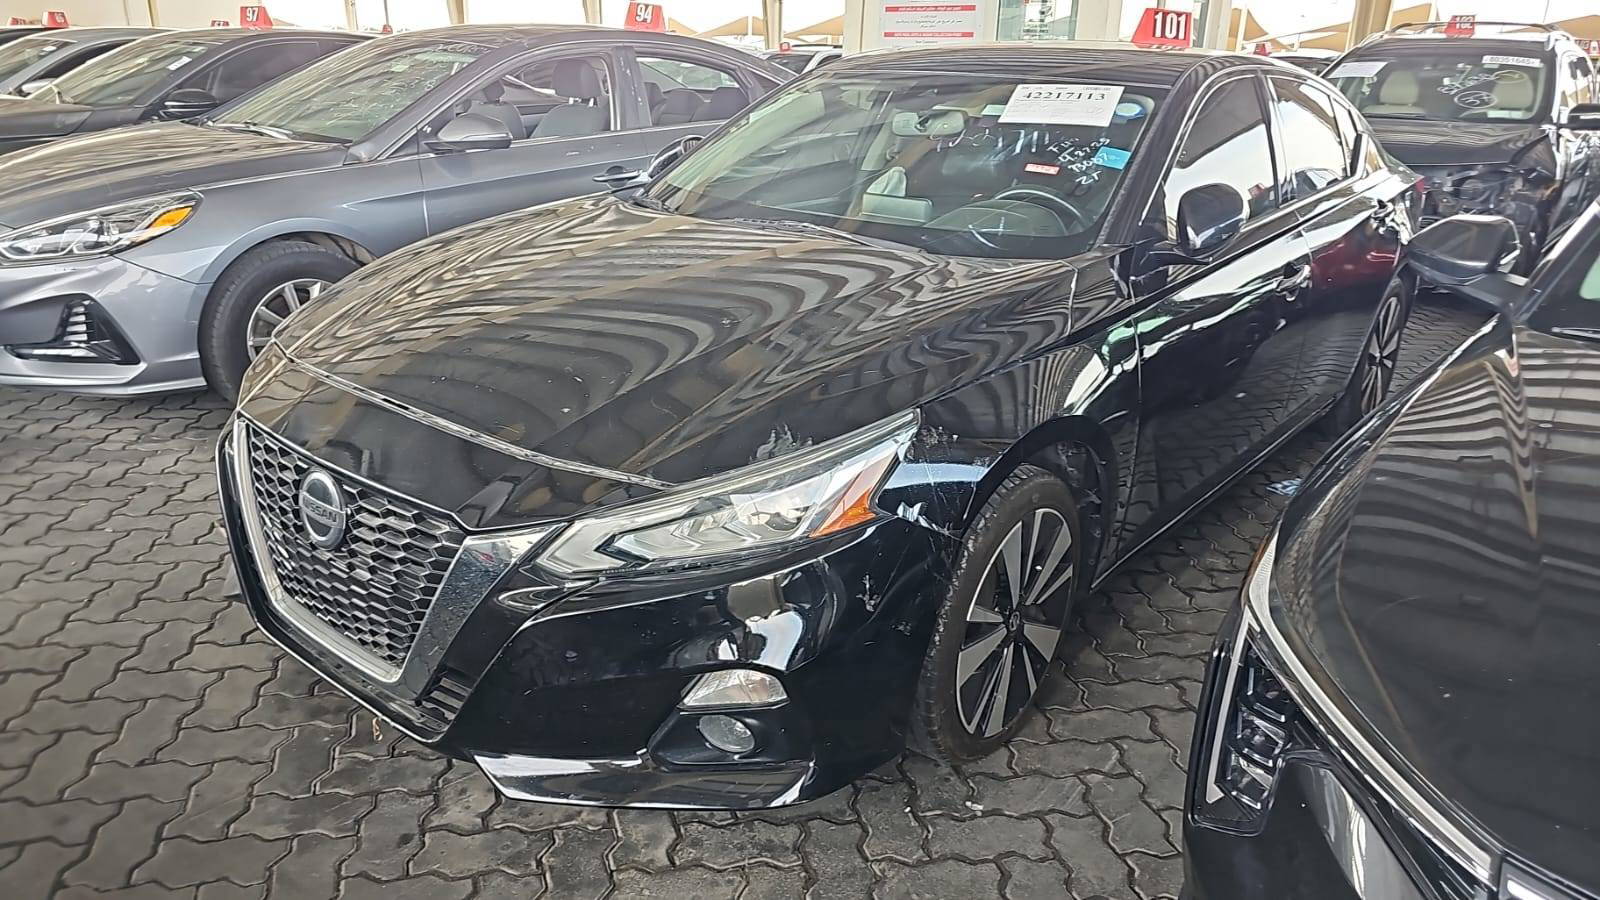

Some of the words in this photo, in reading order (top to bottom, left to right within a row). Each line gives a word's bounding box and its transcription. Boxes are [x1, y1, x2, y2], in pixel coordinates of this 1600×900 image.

[246, 7, 259, 22] 97
[635, 4, 653, 23] 94
[1154, 11, 1187, 40] 101
[1022, 91, 1106, 101] 42217113
[303, 497, 338, 522] NISSAN
